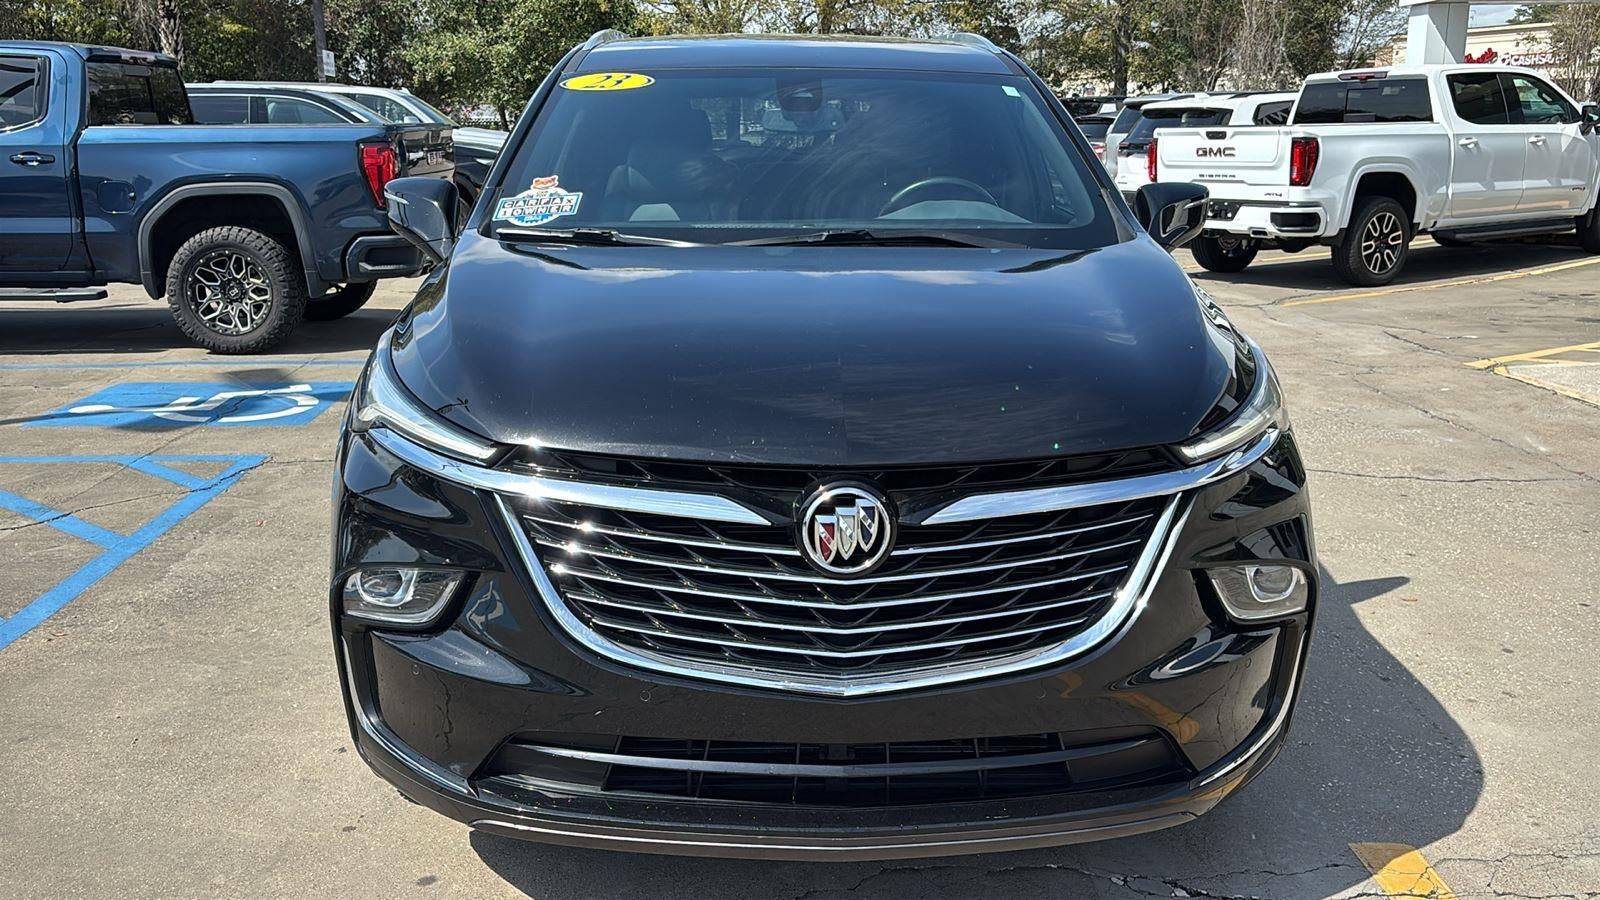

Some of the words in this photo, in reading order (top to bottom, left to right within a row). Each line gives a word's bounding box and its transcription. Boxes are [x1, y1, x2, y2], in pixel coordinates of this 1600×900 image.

[581, 75, 631, 88] 23
[1196, 147, 1236, 158] GMC
[502, 196, 574, 209] CARFAX
[513, 205, 571, 216] OWNER
